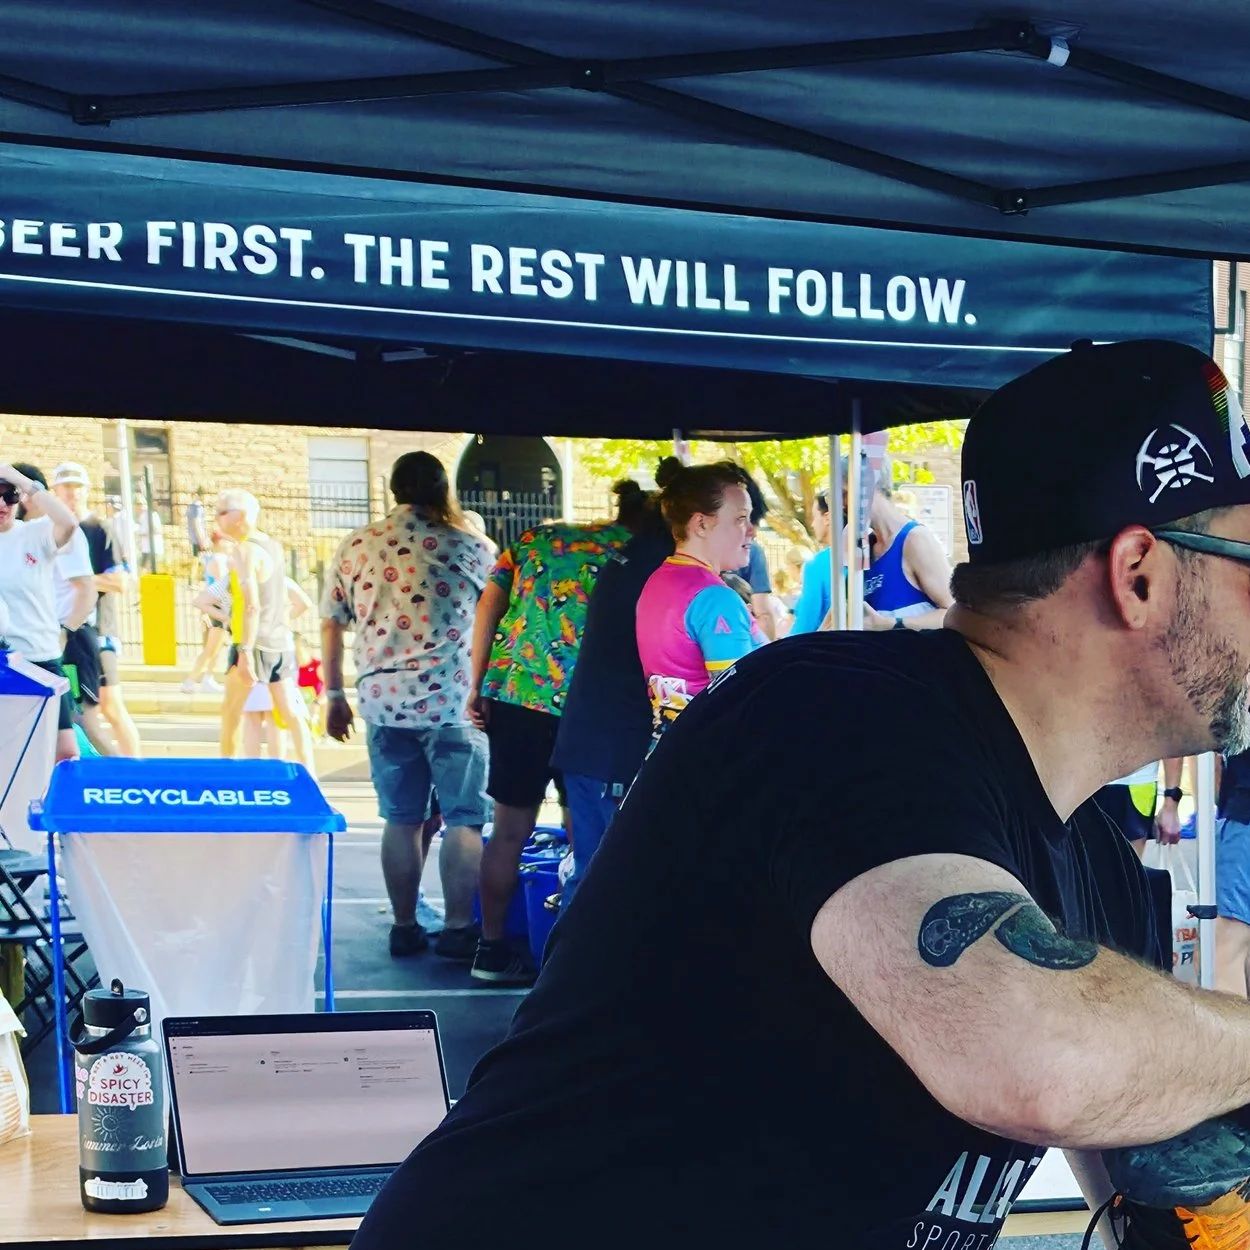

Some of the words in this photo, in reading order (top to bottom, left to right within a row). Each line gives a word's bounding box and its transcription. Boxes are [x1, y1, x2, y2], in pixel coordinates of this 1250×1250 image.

[0, 218, 123, 261] EER
[146, 221, 325, 280] FIRST.
[344, 233, 450, 289] THE
[470, 244, 605, 301] REST
[621, 256, 750, 312] WILL
[767, 267, 978, 325] FOLLOW.
[83, 788, 291, 806] RECYCLABLES
[100, 1078, 141, 1090] SPICY
[89, 1091, 152, 1105] DISASTER
